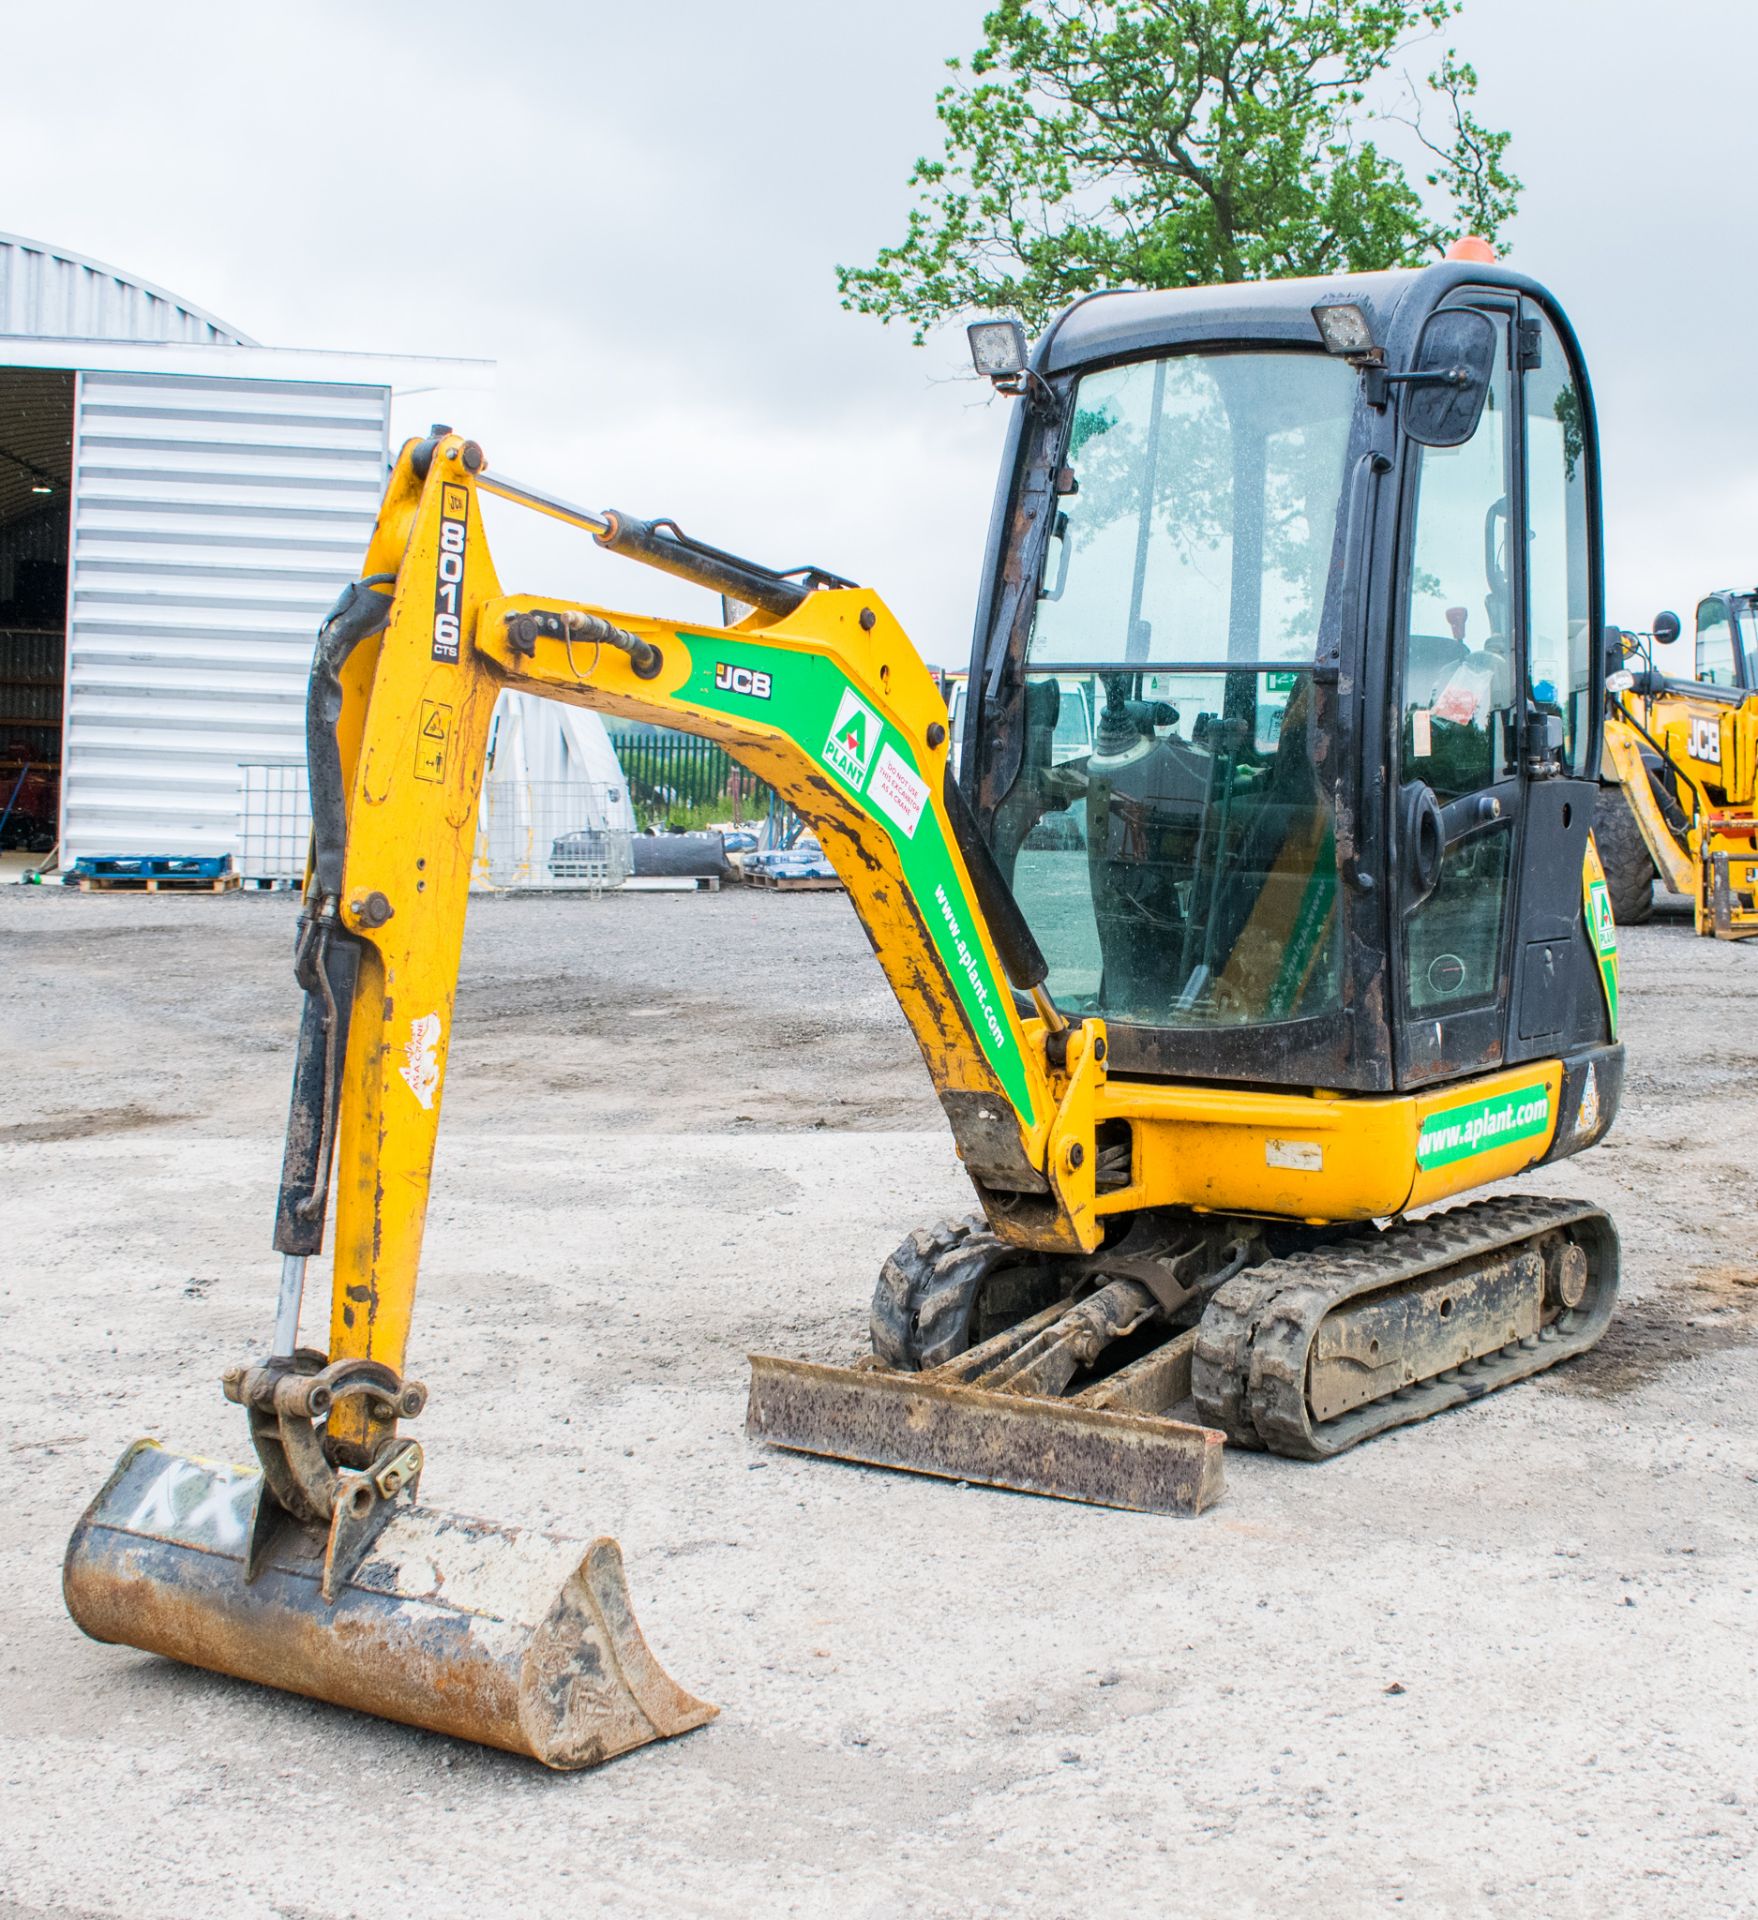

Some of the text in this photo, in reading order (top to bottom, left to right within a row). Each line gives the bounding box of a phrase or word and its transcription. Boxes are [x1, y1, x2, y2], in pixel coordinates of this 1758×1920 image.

[435, 521, 465, 646] 8016
[433, 644, 458, 657] CTS
[716, 664, 771, 699] JCB
[834, 710, 866, 764] A
[1687, 717, 1721, 763] JCB
[825, 741, 864, 784] PLANT
[887, 763, 919, 798] DO NOT USE
[879, 767, 920, 813] THIS EXCAVATOR
[881, 783, 889, 793] AS
[893, 795, 912, 816] CRANE
[934, 884, 1005, 1049] www.aplant.com
[1417, 1098, 1548, 1156] www.aplant.com
